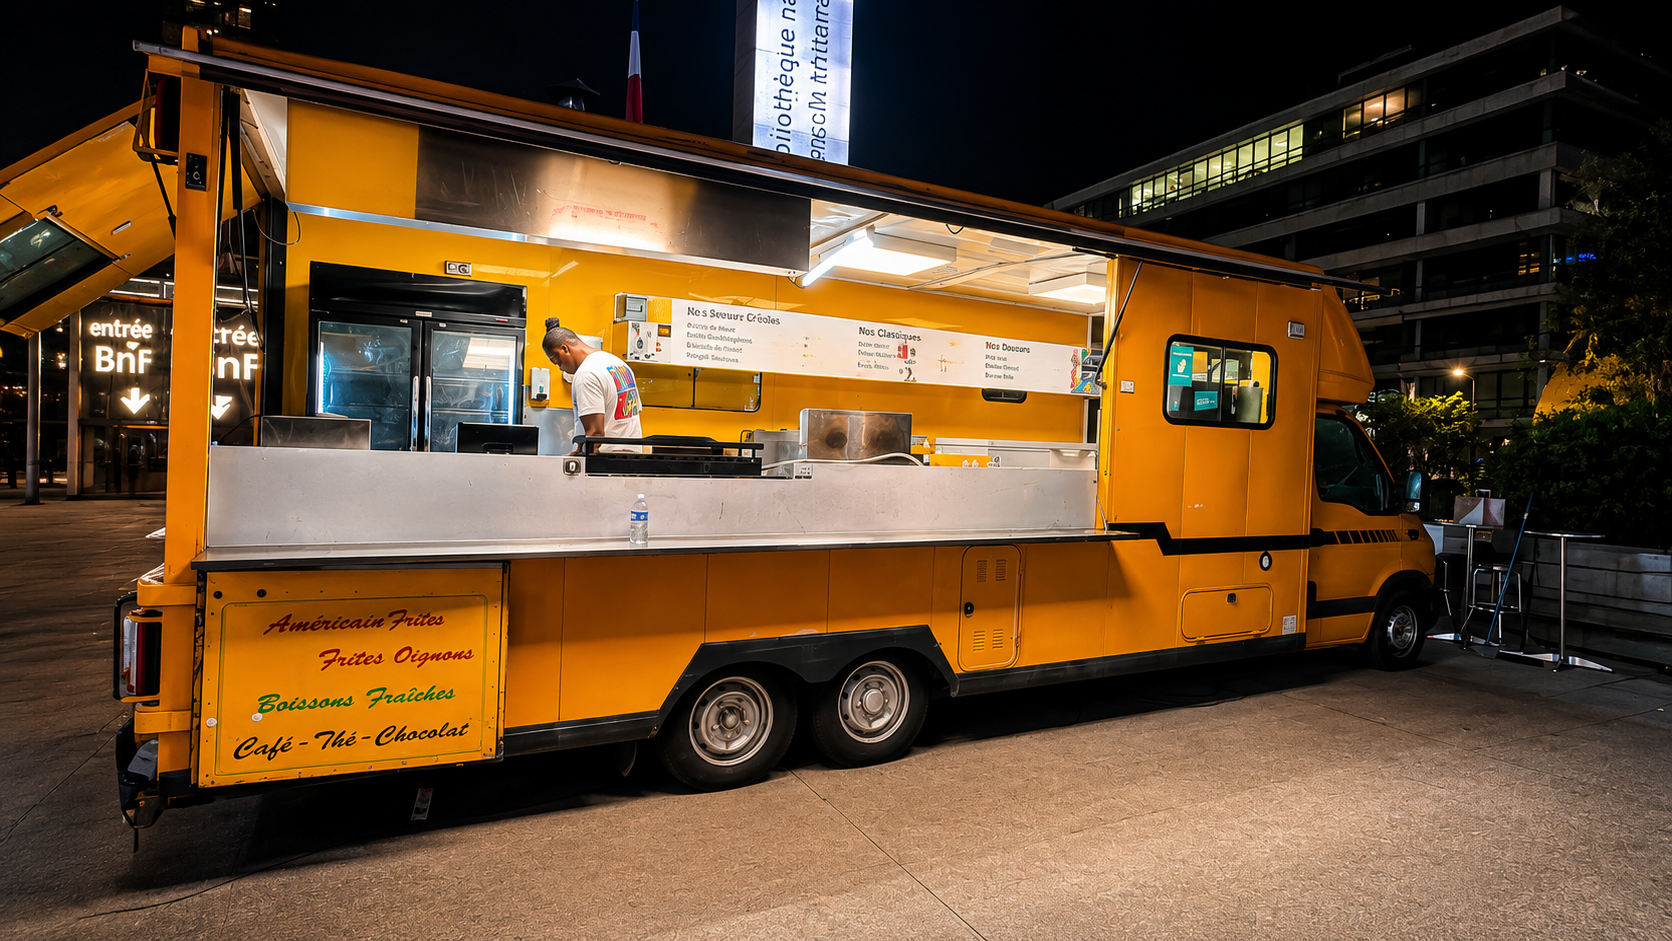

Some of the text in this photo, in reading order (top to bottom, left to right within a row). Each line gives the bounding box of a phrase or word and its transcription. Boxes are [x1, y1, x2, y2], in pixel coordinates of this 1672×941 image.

[89, 318, 153, 339] entrée
[213, 325, 259, 347] rée
[859, 326, 876, 337] Nos
[95, 345, 152, 374] BnF
[217, 353, 259, 380] nF
[263, 609, 446, 635] Américain Frites
[318, 646, 475, 672] Frites Oignons
[257, 685, 456, 714] Boissons Fraîches
[232, 736, 294, 761] Café
[314, 730, 358, 752] Thé
[374, 721, 470, 747] Chocolat
